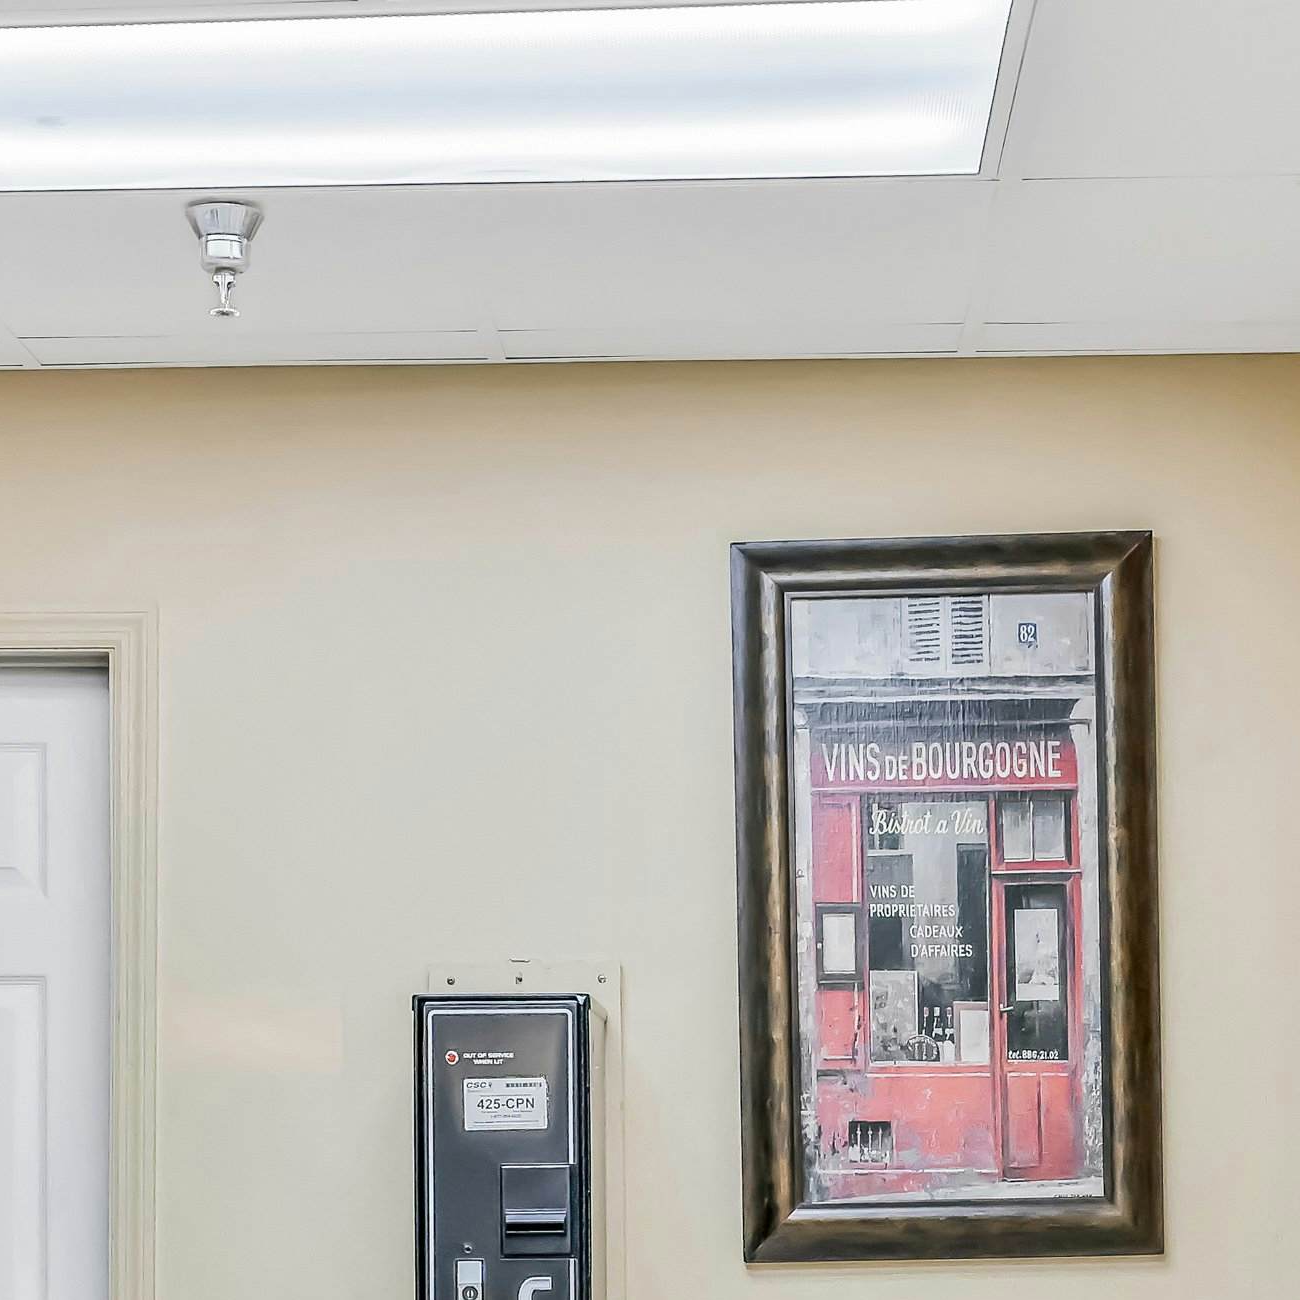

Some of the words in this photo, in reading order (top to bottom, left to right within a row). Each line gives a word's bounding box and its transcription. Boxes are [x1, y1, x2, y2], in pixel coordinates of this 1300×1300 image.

[1020, 625, 1035, 641] 82
[822, 743, 881, 782] VINS
[885, 755, 908, 780] DE
[912, 740, 1062, 780] BOURGOGNE
[869, 807, 933, 835] Bistrot
[934, 820, 948, 835] a
[951, 808, 984, 835] Vin
[869, 885, 897, 898] VINS
[901, 885, 915, 898] DE
[869, 903, 956, 918] PROPRIETAIRES
[909, 925, 964, 938] CADEAUX
[911, 944, 973, 958] D'AFFAIRES
[477, 1097, 535, 1110] 425-CPN
